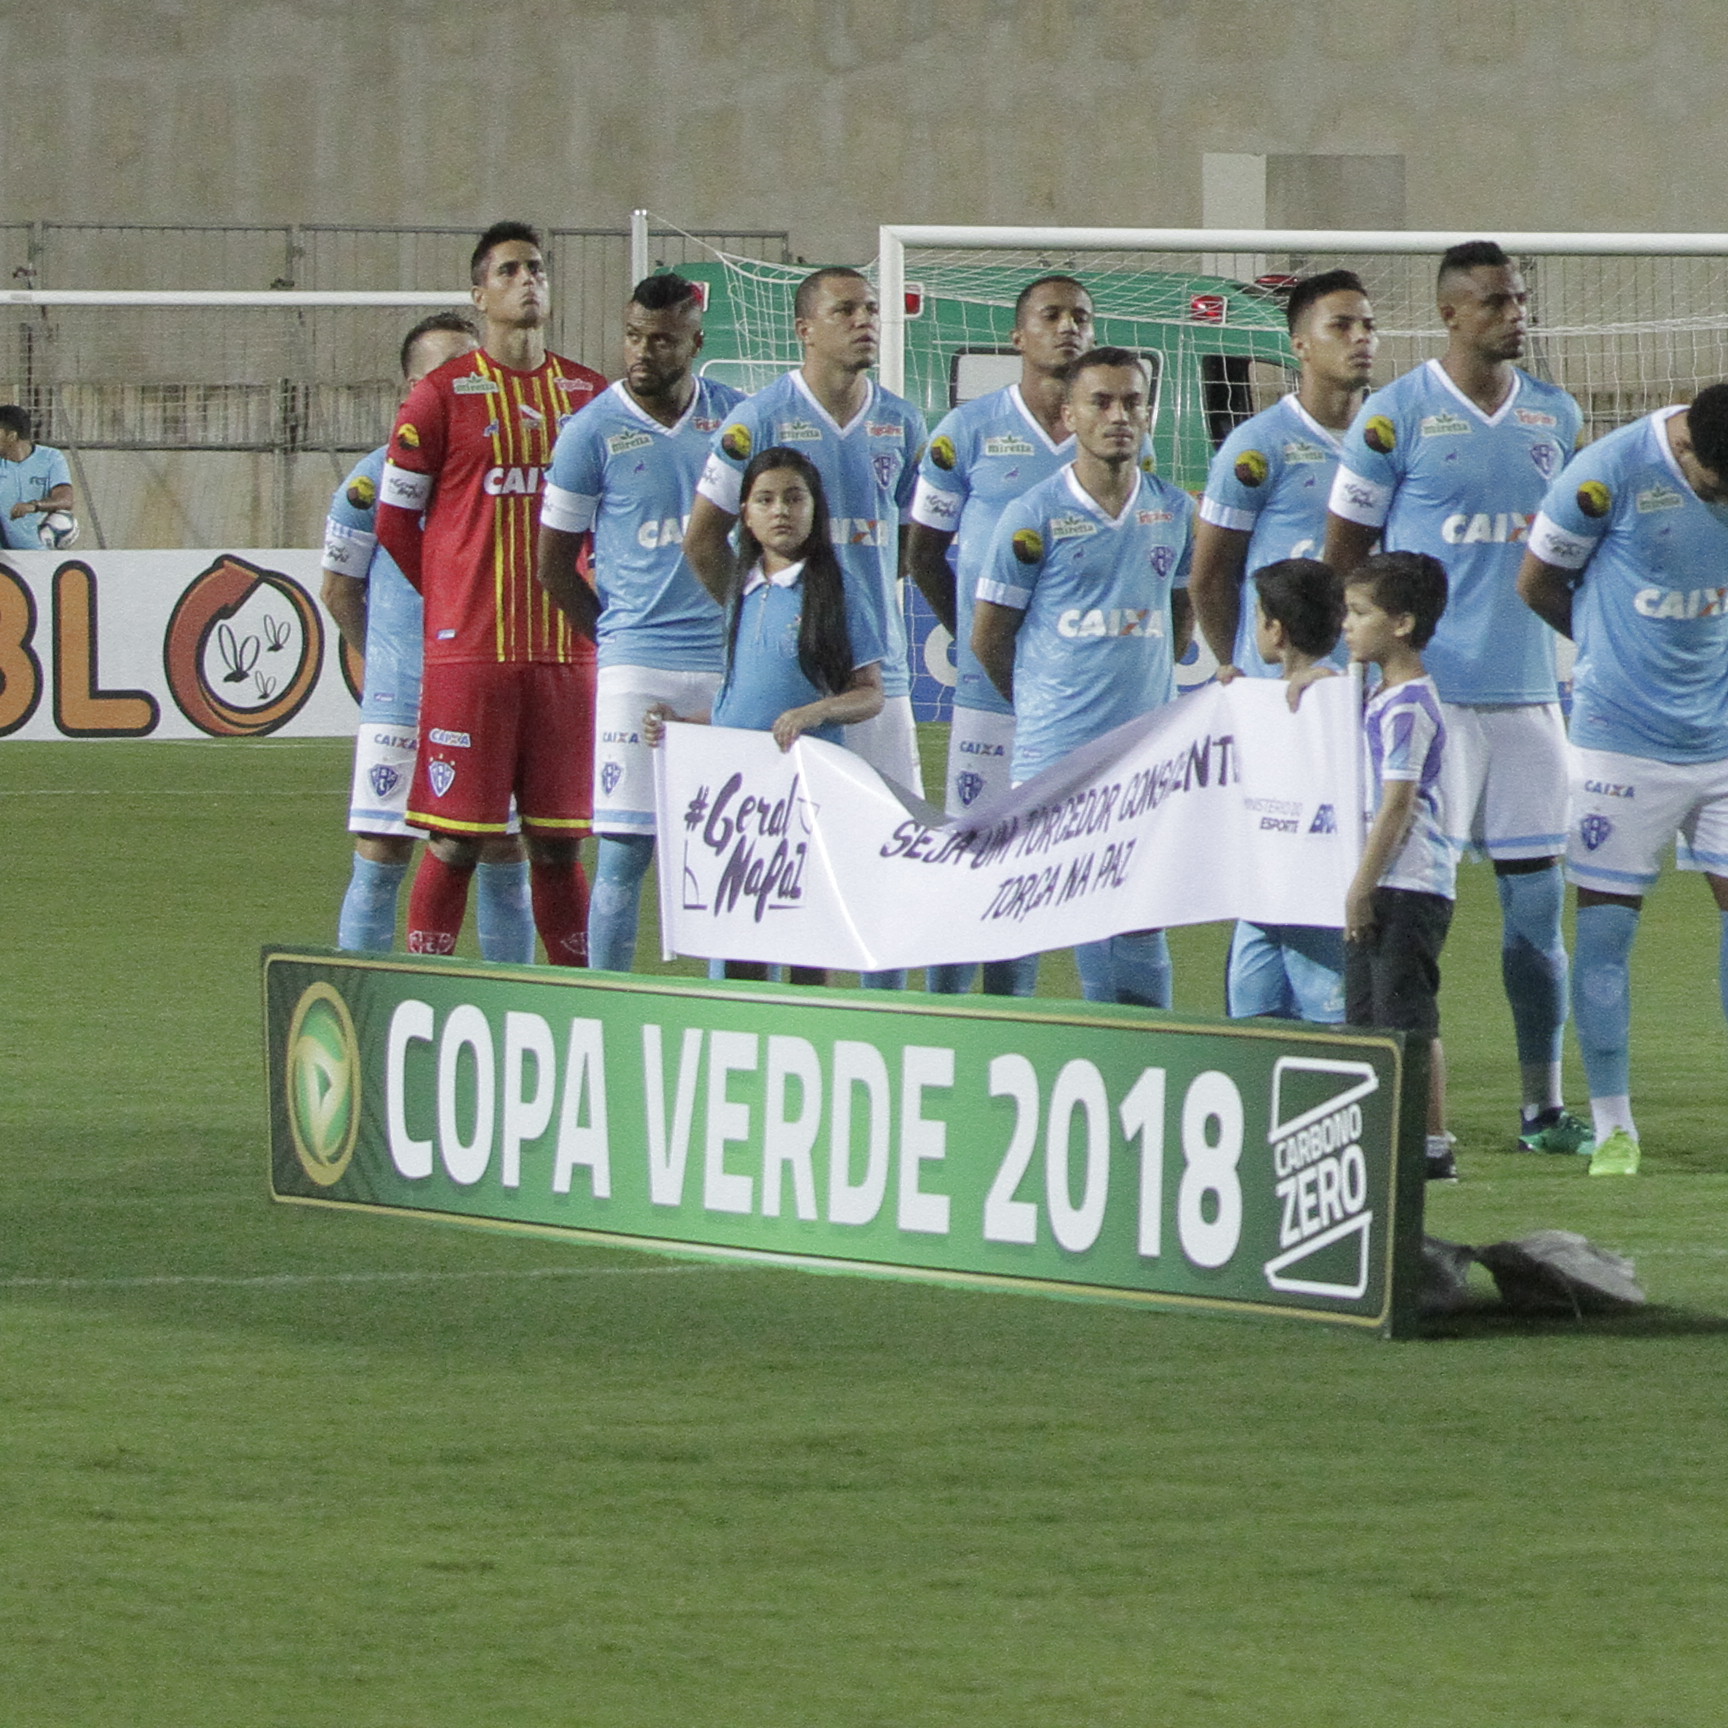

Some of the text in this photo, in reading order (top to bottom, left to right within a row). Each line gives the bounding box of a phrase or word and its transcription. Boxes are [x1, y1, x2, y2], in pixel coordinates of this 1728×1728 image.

[1442, 514, 1537, 544] CAIX
[1057, 609, 1164, 638] CAIXA
[374, 733, 418, 751] CAIXA
[430, 730, 470, 746] CAIXA
[959, 740, 1005, 757] CAIXA
[1583, 779, 1636, 799] CAIXA
[684, 771, 799, 857] #Geral
[880, 819, 977, 865] SEJA
[1015, 782, 1121, 859] TORCEDOR
[1259, 817, 1300, 834] ESPORTE
[980, 863, 1062, 923] TORÇA
[1055, 851, 1095, 907] NA
[386, 998, 1244, 1269] COPA VERDE 2018
[1273, 1102, 1364, 1178] CARBONO
[1276, 1143, 1367, 1249] ZERO
